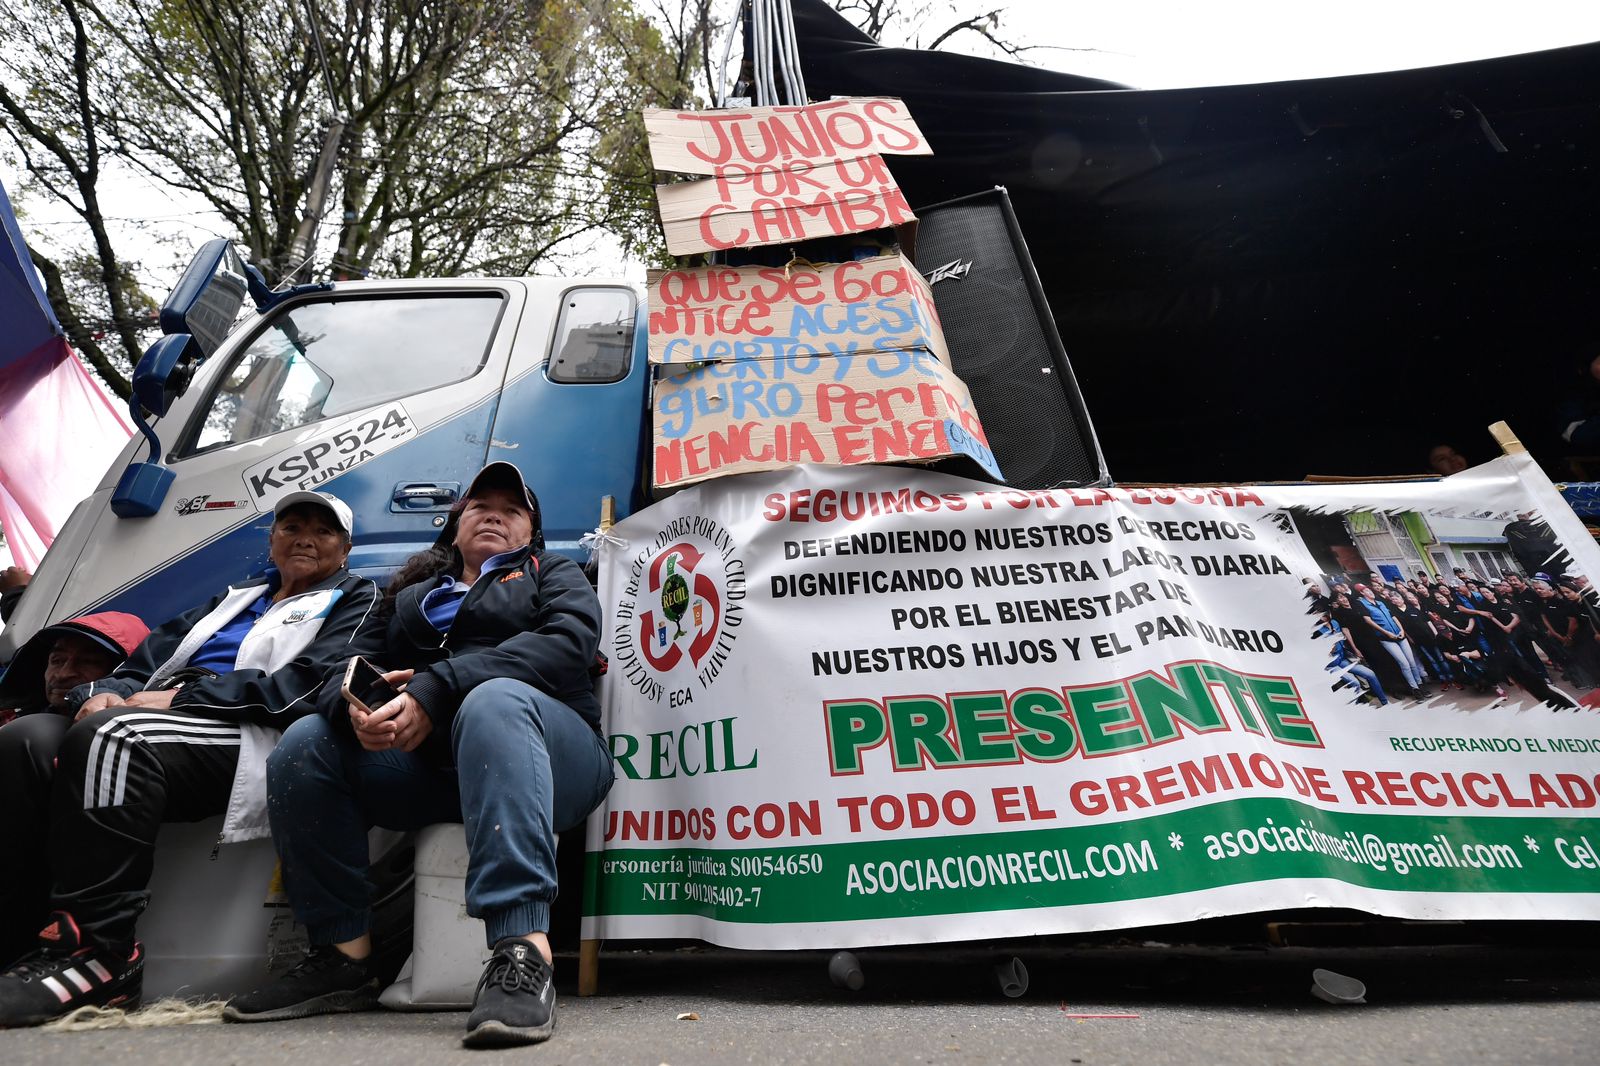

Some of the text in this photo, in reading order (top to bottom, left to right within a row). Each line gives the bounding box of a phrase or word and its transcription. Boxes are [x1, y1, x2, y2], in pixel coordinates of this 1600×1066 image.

[677, 101, 919, 165] JUNTOS
[714, 155, 829, 202] POR
[826, 341, 859, 381] Y
[298, 450, 375, 491] FUNZA
[656, 421, 826, 484] NENCIA
[692, 515, 716, 541] POR
[763, 488, 968, 522] SEGUIMOS
[625, 515, 691, 598] RECICLADORES
[714, 527, 736, 561] UNA
[784, 515, 1256, 560] DEFENDIENDO NUESTROS DERECHOS
[724, 559, 747, 628] CIUDAD
[771, 546, 1292, 598] DIGNIFICANDO NUESTRA LABOR DIARIA
[617, 600, 636, 620] DE
[662, 587, 689, 608] RECIL
[891, 579, 1193, 631] POR EL BIENESTAR DE
[698, 630, 736, 690] LIMPIA
[811, 614, 1284, 676] NUESTROS HIJOS Y EL PAN DIARIO
[669, 687, 694, 709] ECA
[823, 659, 1326, 778] PRESENTE
[1389, 737, 1522, 753] RECUPERANDO
[1524, 738, 1548, 753] EL
[604, 752, 1600, 841] UNIDOS CON TODO EL GREMIO DE RECICLAD
[603, 853, 823, 878] ersonería jurídica S0054650
[846, 839, 1159, 896] ASOCIACIONRECIL.COM
[1554, 835, 1600, 869] Cel
[642, 882, 762, 908] NIT 901205402-7
